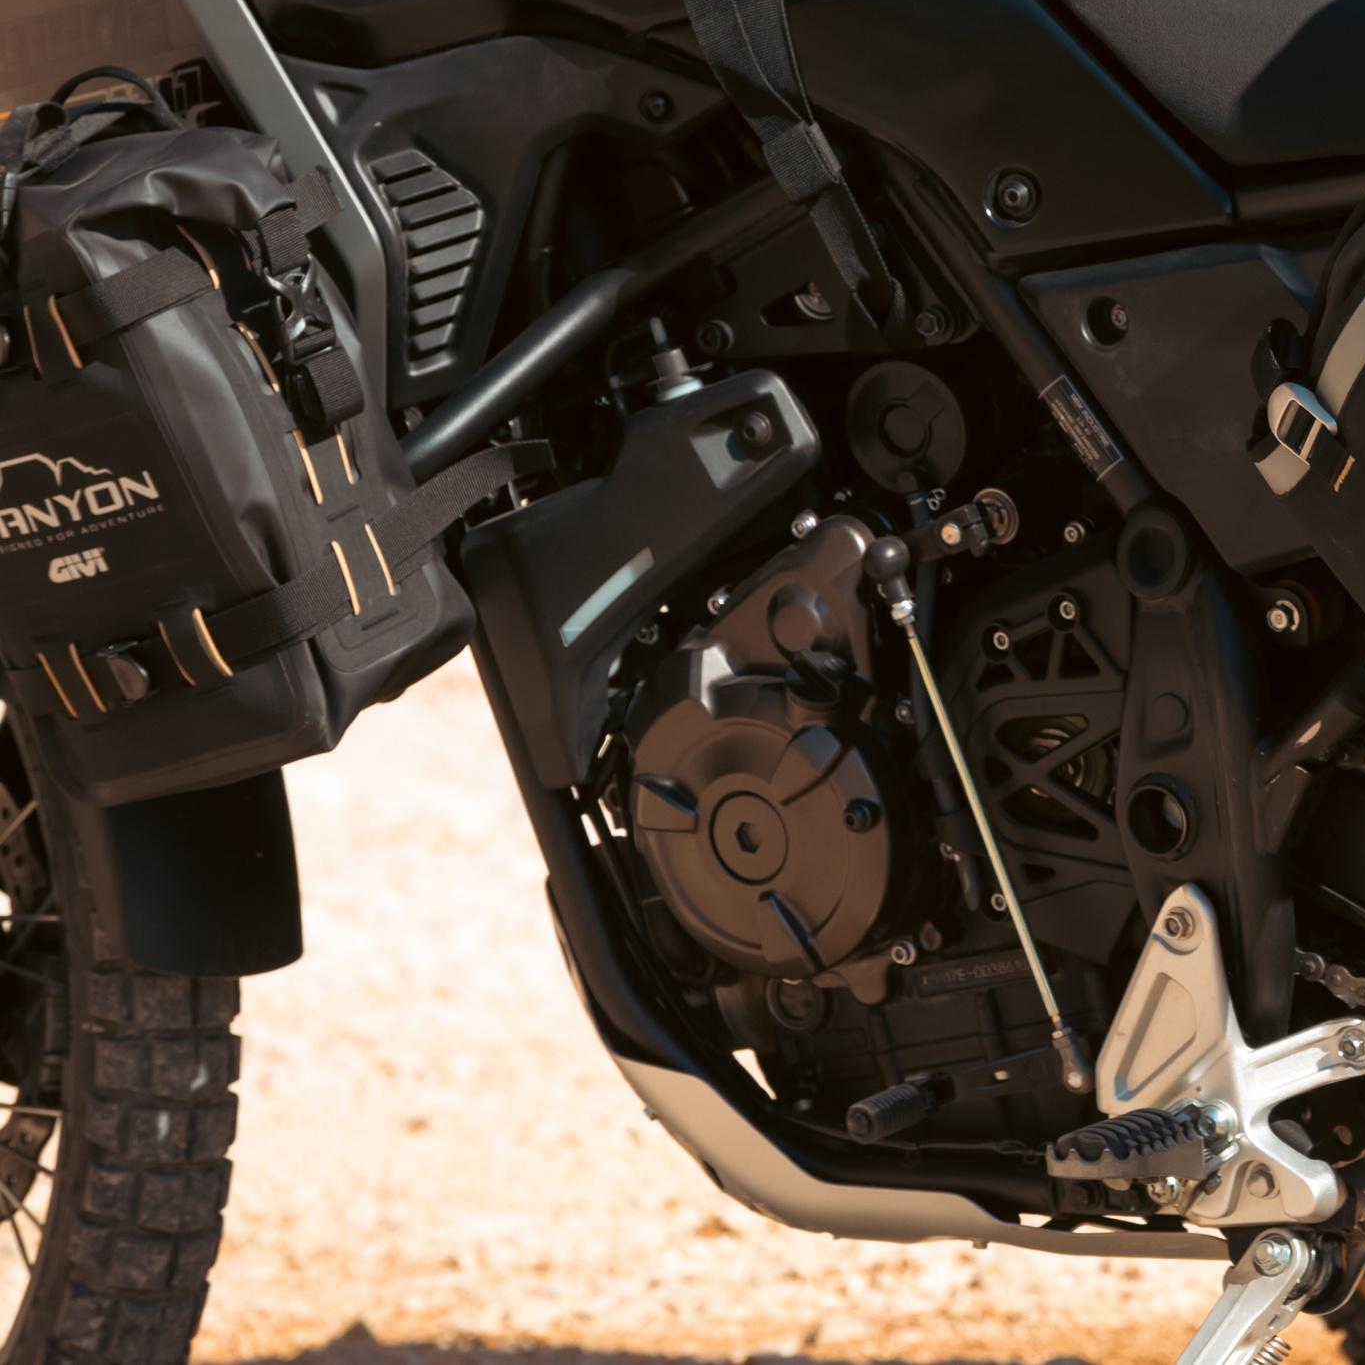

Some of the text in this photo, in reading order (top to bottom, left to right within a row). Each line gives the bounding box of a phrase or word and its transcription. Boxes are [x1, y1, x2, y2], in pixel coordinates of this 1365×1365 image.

[0, 470, 159, 538] ANYON
[0, 503, 165, 554] SIGNED FOR ADVENTURE
[48, 547, 109, 583] GIVI
